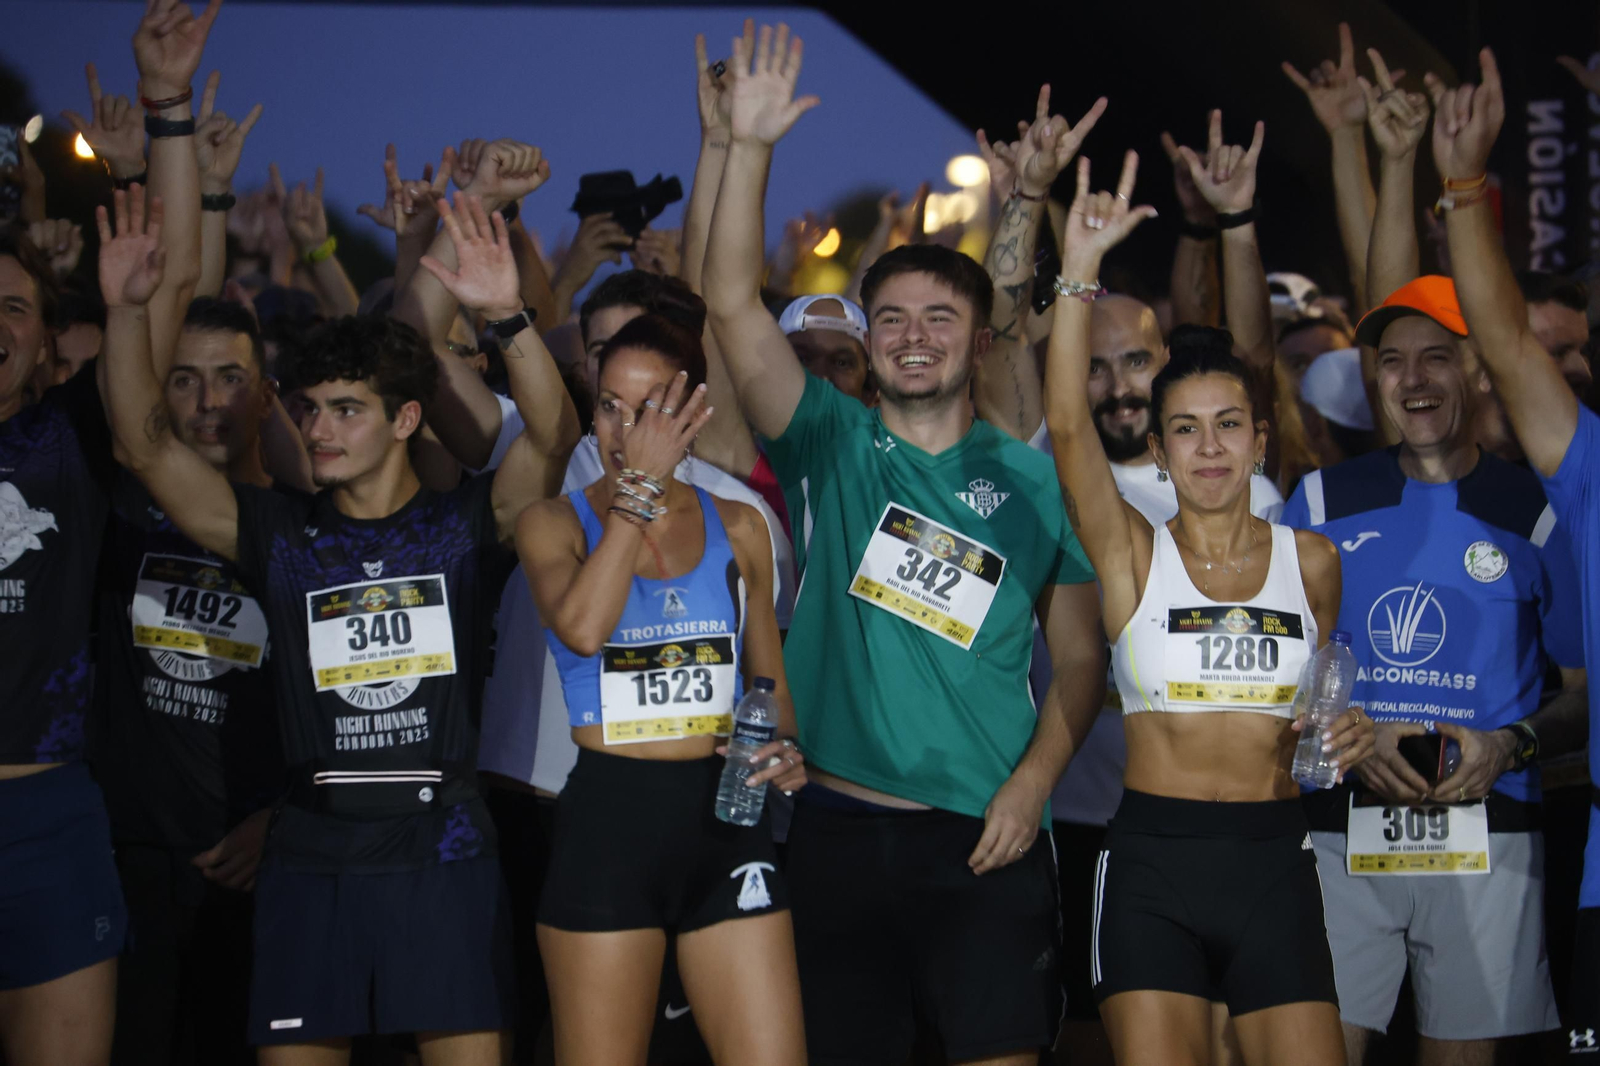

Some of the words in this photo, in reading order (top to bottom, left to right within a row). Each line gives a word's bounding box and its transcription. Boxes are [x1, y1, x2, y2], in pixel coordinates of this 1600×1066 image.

[896, 547, 962, 602] 342
[164, 586, 242, 629] 1492
[346, 611, 412, 651] 340
[620, 620, 728, 642] TROTASIERRA
[1262, 617, 1281, 626] ROCK
[1263, 625, 1275, 634] FM
[1276, 626, 1288, 635] 500
[1196, 635, 1279, 672] 1280
[173, 682, 229, 709] RUNNING
[631, 668, 713, 706] 1523
[335, 715, 371, 735] NIGHT
[373, 707, 428, 732] RUNNING
[1398, 702, 1440, 715] RECICLADO
[1441, 706, 1447, 716] Y
[1447, 708, 1475, 720] NUEVO
[399, 727, 429, 745] 2025
[1382, 806, 1450, 842] 309
[1402, 844, 1425, 852] CUESTA
